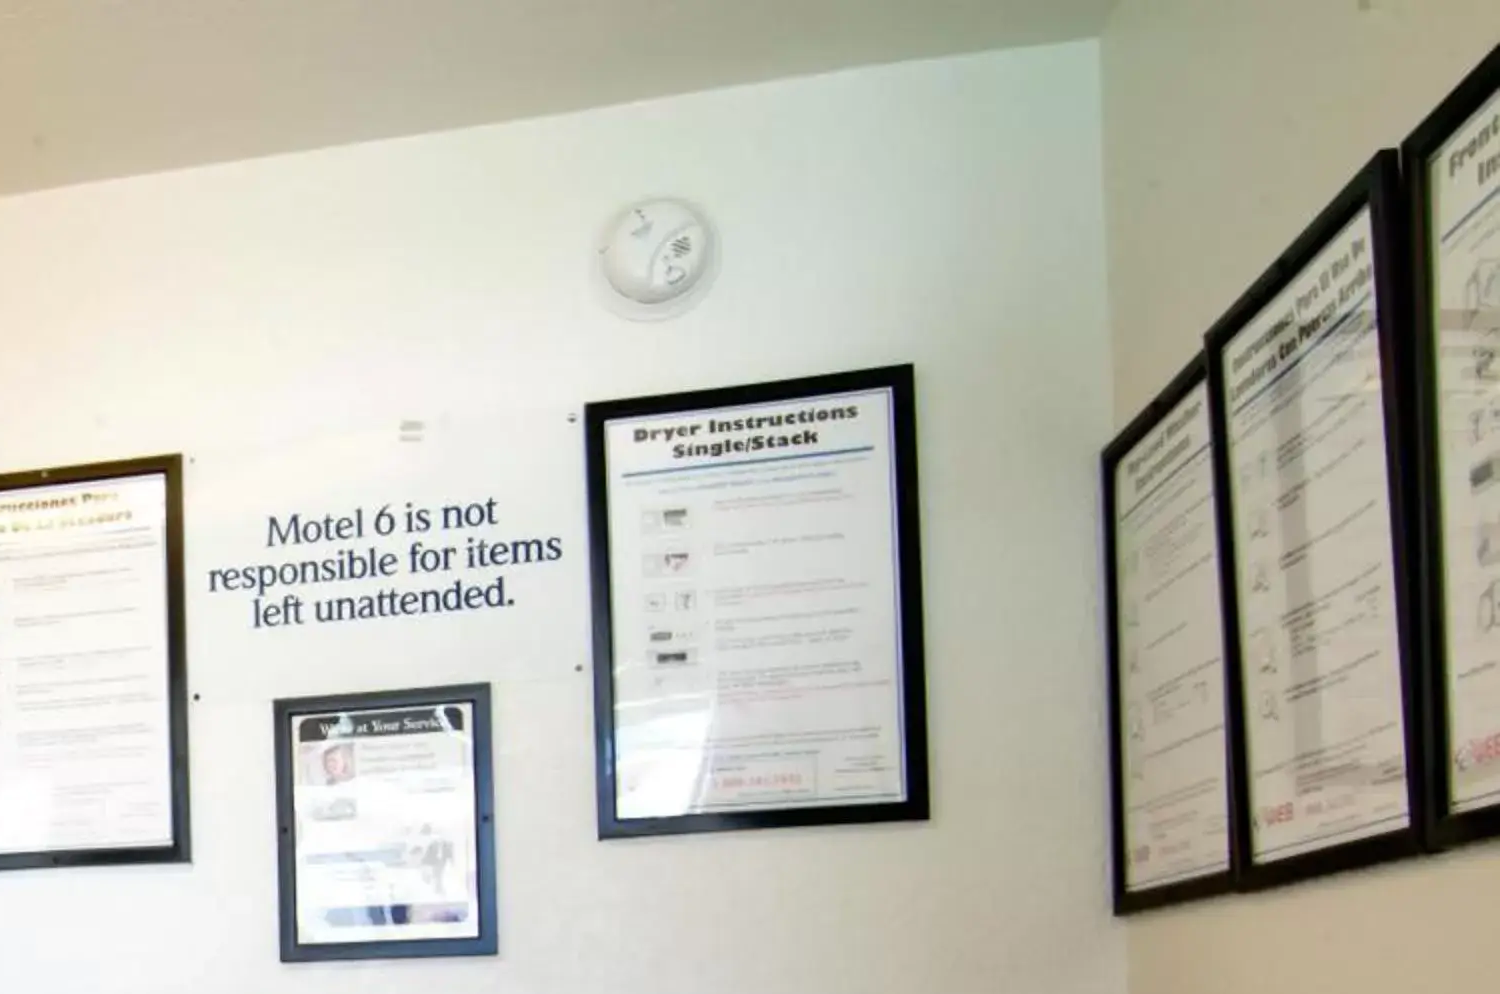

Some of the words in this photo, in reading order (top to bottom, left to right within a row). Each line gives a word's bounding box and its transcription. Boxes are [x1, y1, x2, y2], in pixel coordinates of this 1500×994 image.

[633, 422, 702, 443] Dryer
[709, 405, 859, 434] Instructions
[672, 430, 819, 459] Single/Stack
[266, 508, 363, 548] Motel
[373, 504, 396, 537] 6
[405, 502, 431, 533] is
[441, 497, 498, 530] not
[208, 546, 398, 596] responsible
[408, 541, 456, 574] for
[466, 535, 563, 570] items
[252, 595, 304, 629] left
[315, 576, 516, 623] unattended.
[371, 719, 399, 731] Your
